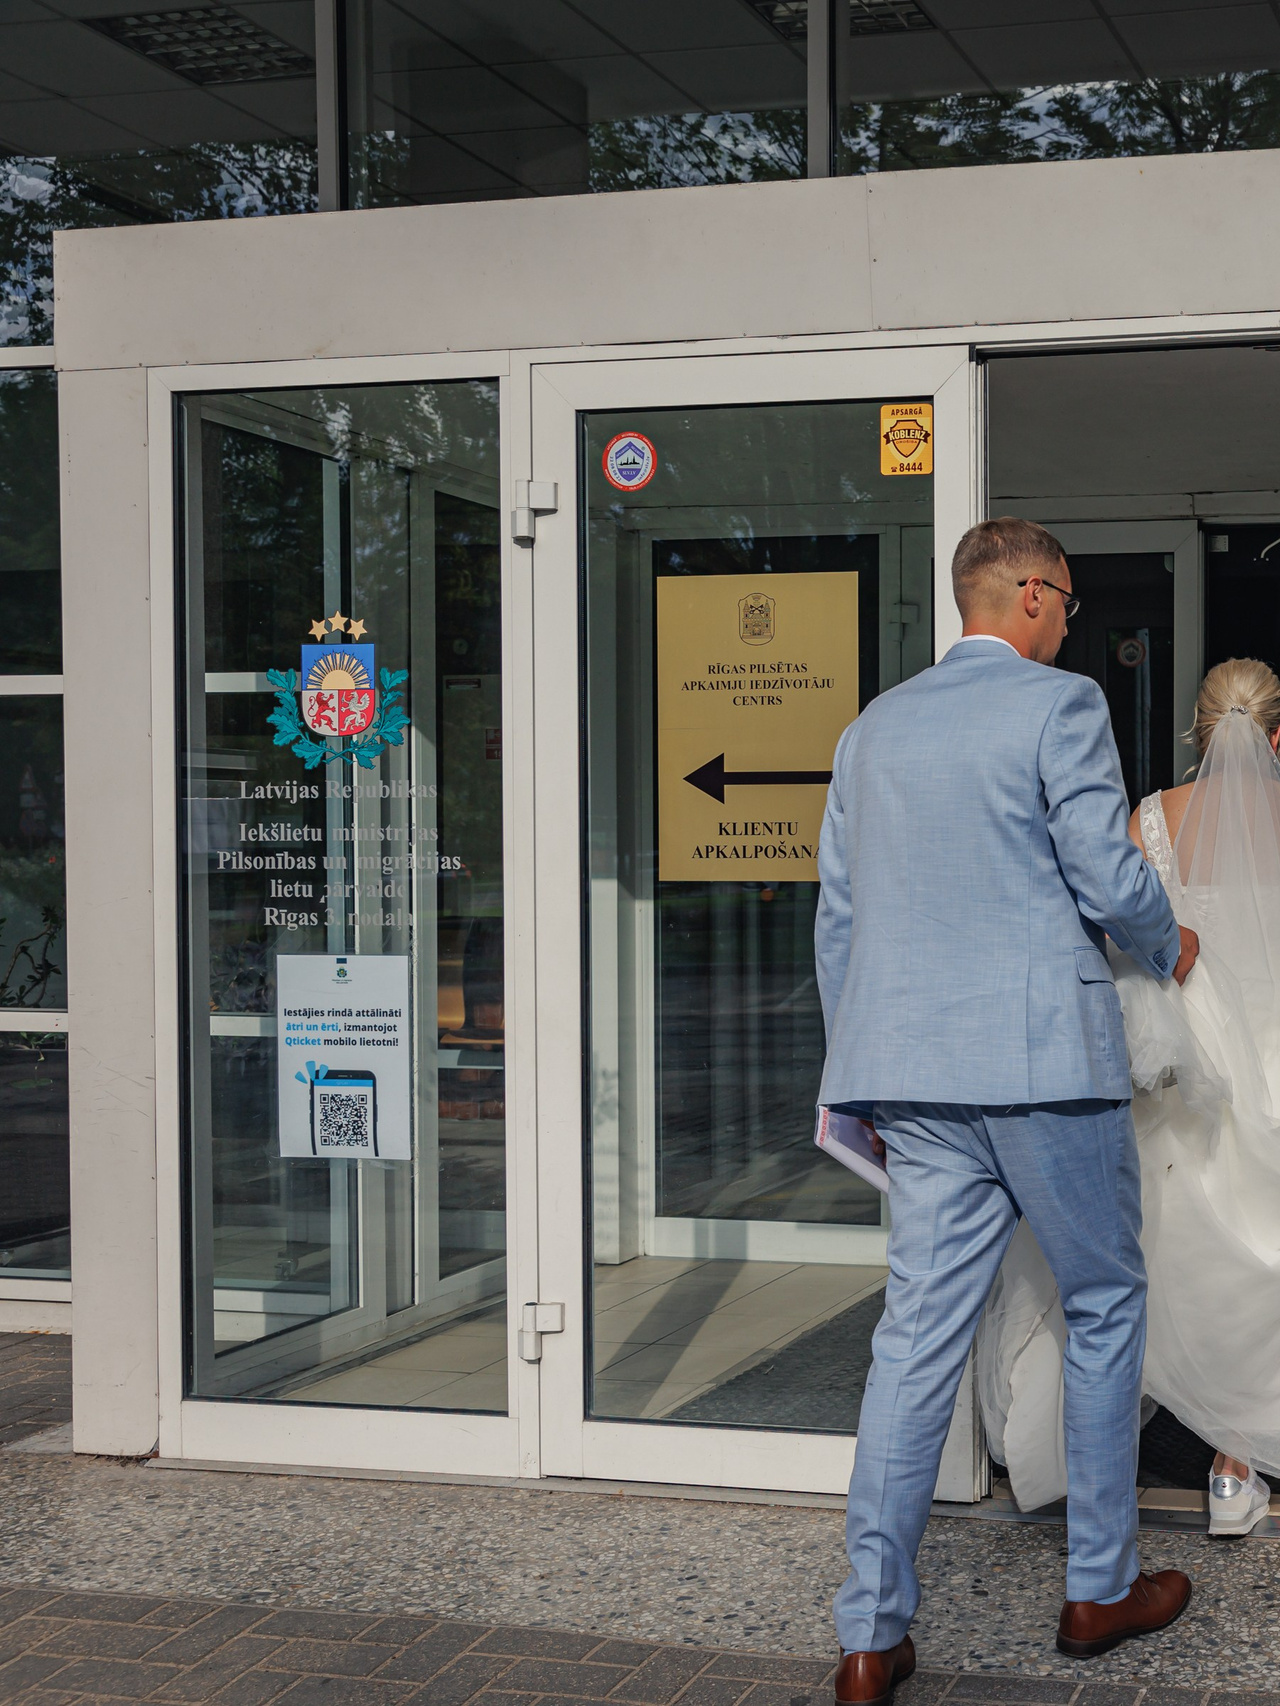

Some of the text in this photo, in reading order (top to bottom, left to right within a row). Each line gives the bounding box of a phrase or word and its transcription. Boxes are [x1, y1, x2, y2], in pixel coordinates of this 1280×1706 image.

[891, 407, 923, 416] APSARGĀ
[888, 429, 926, 440] KOBLENZ
[899, 462, 923, 472] 8444
[708, 661, 808, 675] RĪGAS PILSĒTAS
[681, 677, 835, 691] APKAIMJU IEDZĪVOTĀJU
[732, 695, 783, 706] CENTRS
[240, 780, 438, 804] Latvijas Republikas
[239, 822, 439, 846] Iekšlietu ministrijas
[718, 821, 799, 836] KLIENTU
[217, 851, 462, 875] Pilsonības un migrācijas
[270, 880, 314, 898] lietu
[264, 907, 415, 931] Rīgas 3. nodaļa
[284, 1008, 402, 1019] Iestājies rindā attālināti
[286, 1022, 304, 1031] ātri
[321, 1022, 341, 1033] ērti,
[344, 1023, 397, 1034] izmantojot
[285, 1036, 399, 1047] Qticket mobilo lietotni!
